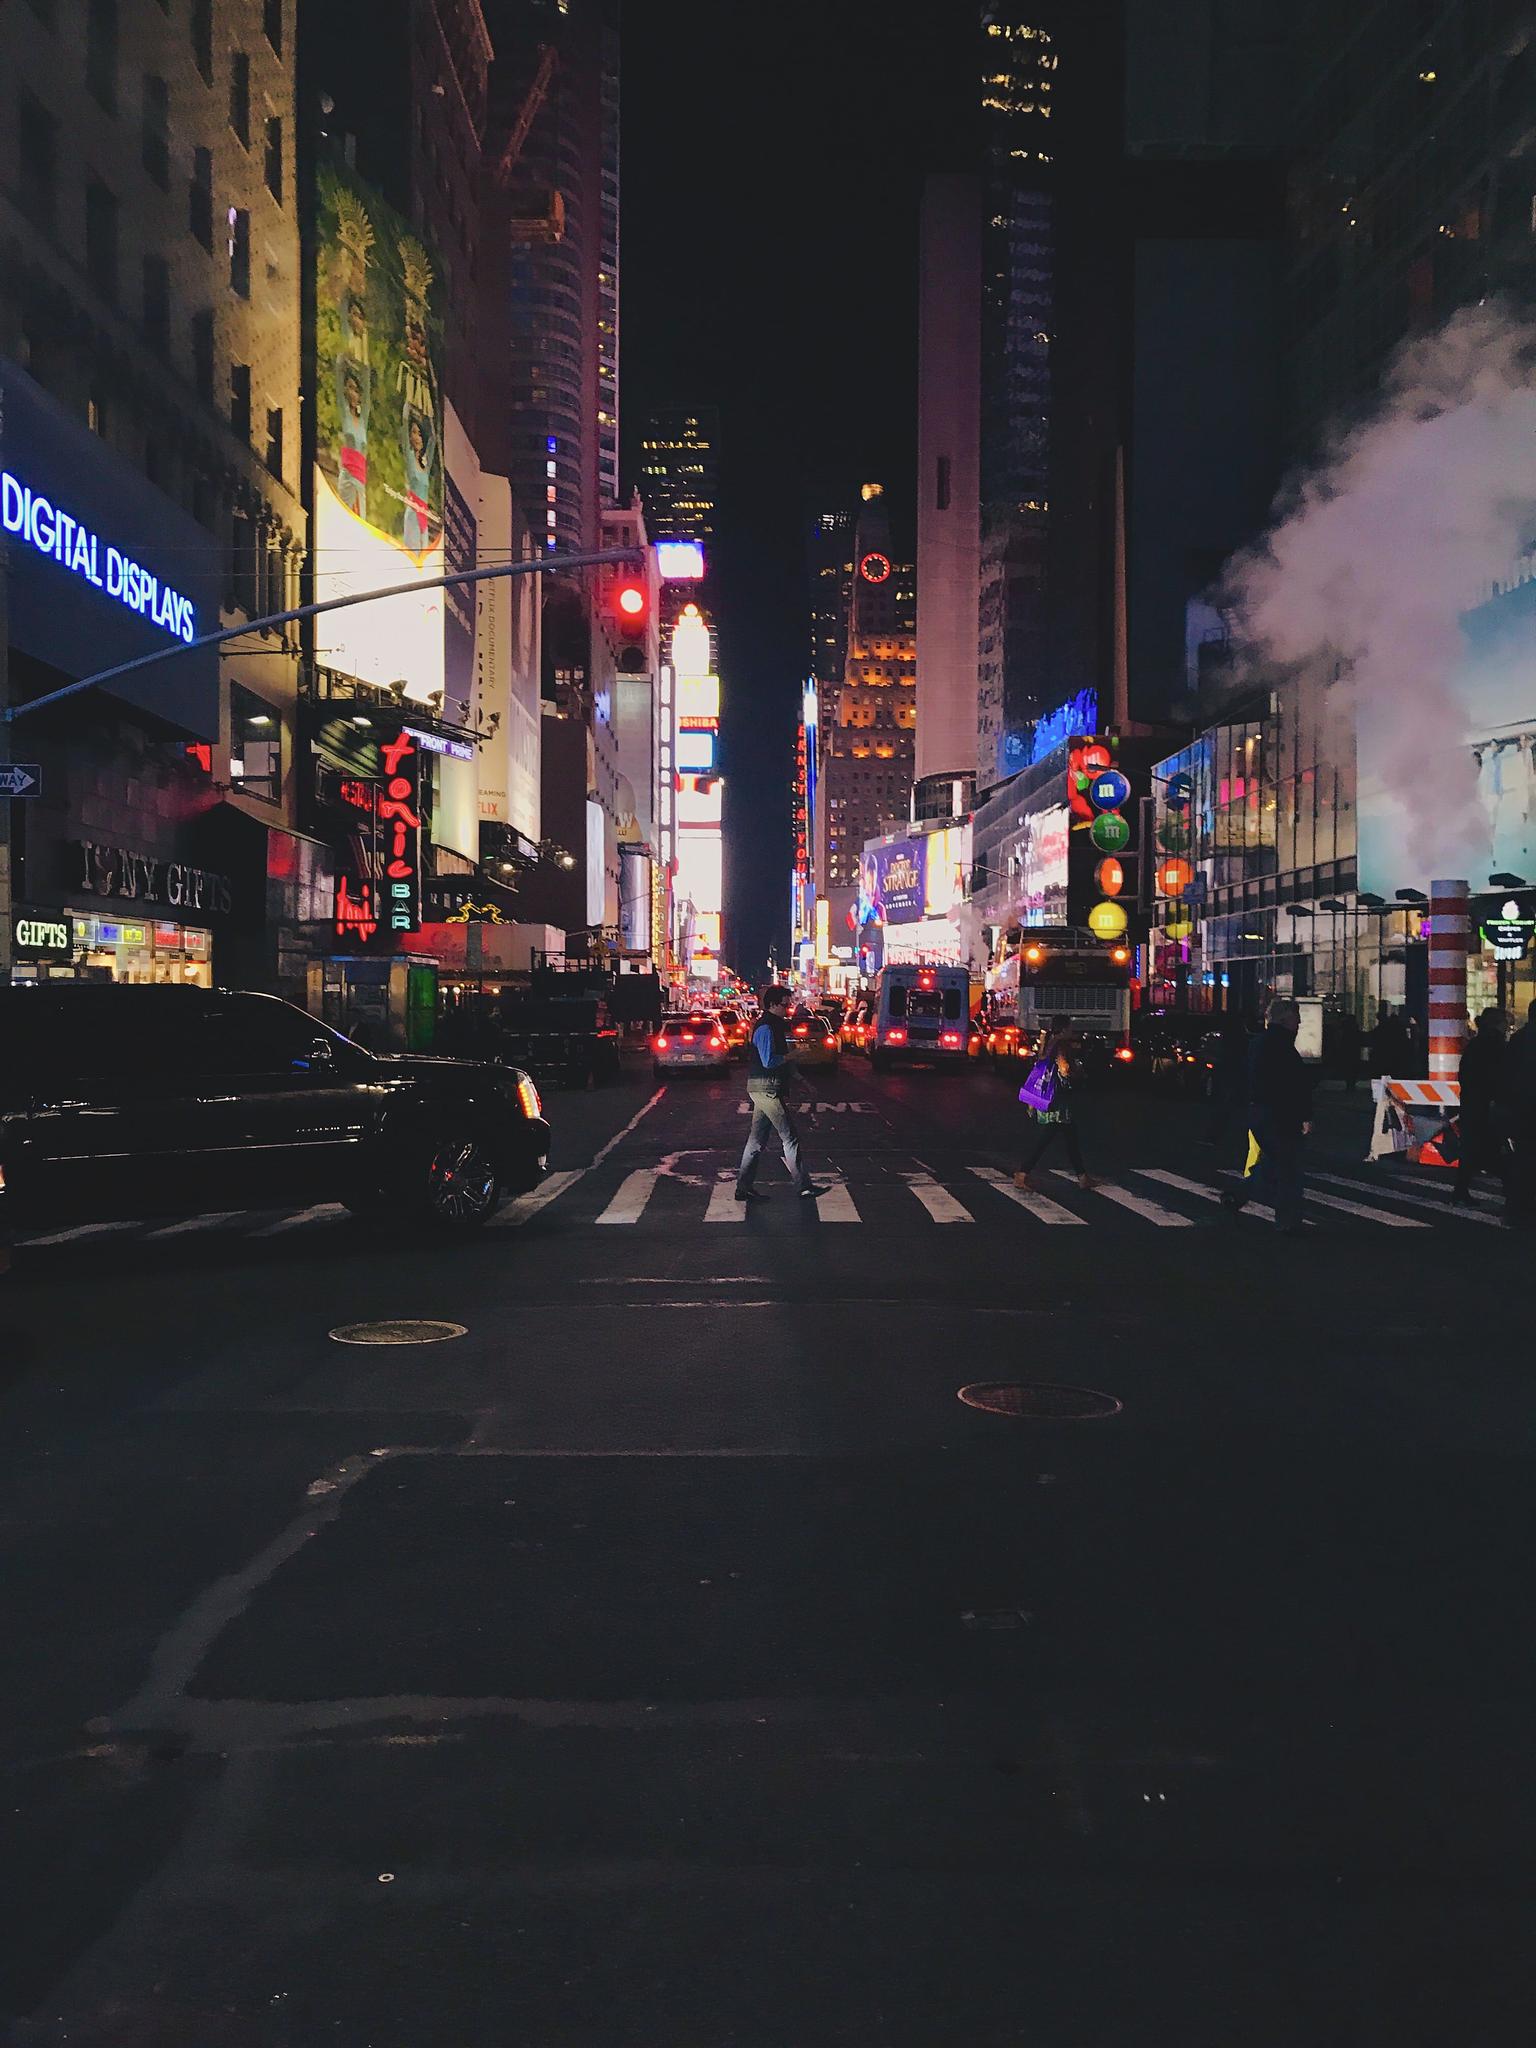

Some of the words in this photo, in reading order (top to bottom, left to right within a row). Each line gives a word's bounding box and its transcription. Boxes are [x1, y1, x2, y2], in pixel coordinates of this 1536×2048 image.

[1, 471, 103, 587] DIGITAL
[106, 547, 194, 643] DISPLAYS
[679, 717, 718, 728] SHIBA
[795, 724, 806, 796] ERNST
[0, 773, 27, 787] WAY
[1099, 784, 1115, 798] m
[479, 789, 506, 798] EAMING
[1105, 826, 1120, 839] m
[118, 849, 158, 901] NY
[167, 862, 233, 914] GIFTS
[883, 870, 918, 892] STRANGE
[391, 883, 411, 930] BAR
[16, 919, 68, 949] GIFTS
